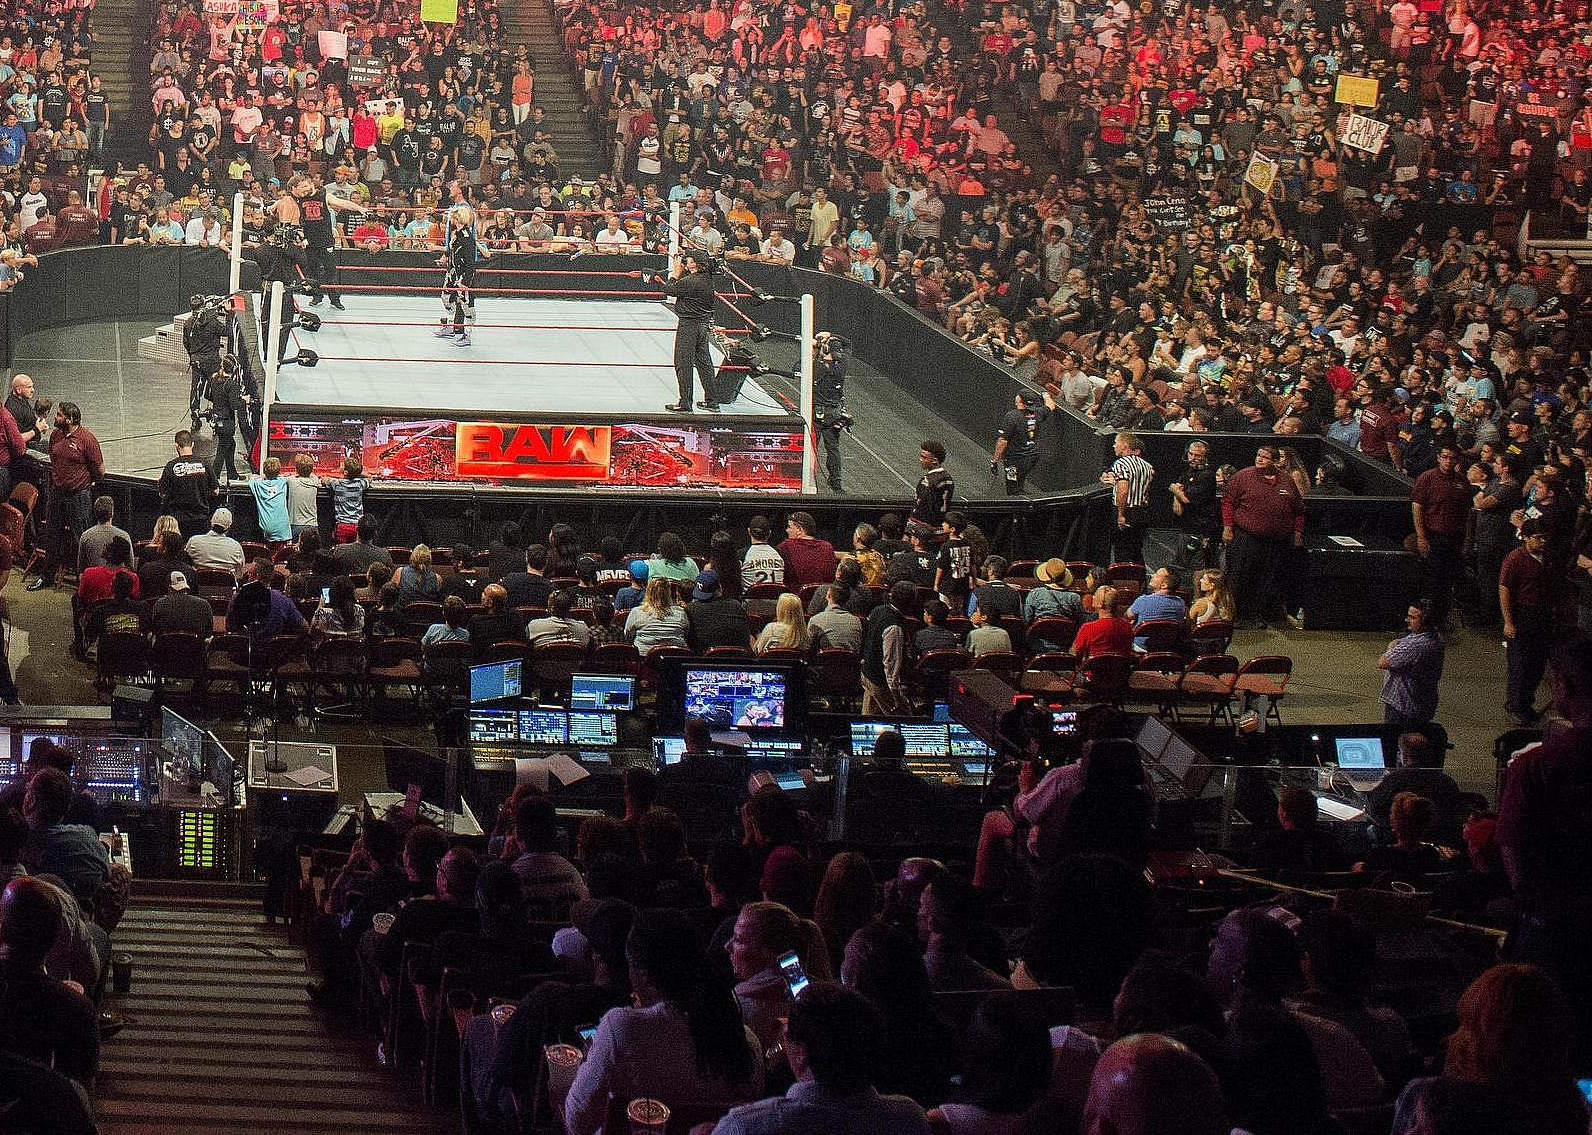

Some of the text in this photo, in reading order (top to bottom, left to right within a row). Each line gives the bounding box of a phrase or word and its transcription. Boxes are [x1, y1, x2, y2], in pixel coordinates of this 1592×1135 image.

[207, 1, 237, 12] ASUKA
[468, 424, 602, 462] RAW
[750, 559, 781, 569] AMORE
[755, 571, 775, 584] 21
